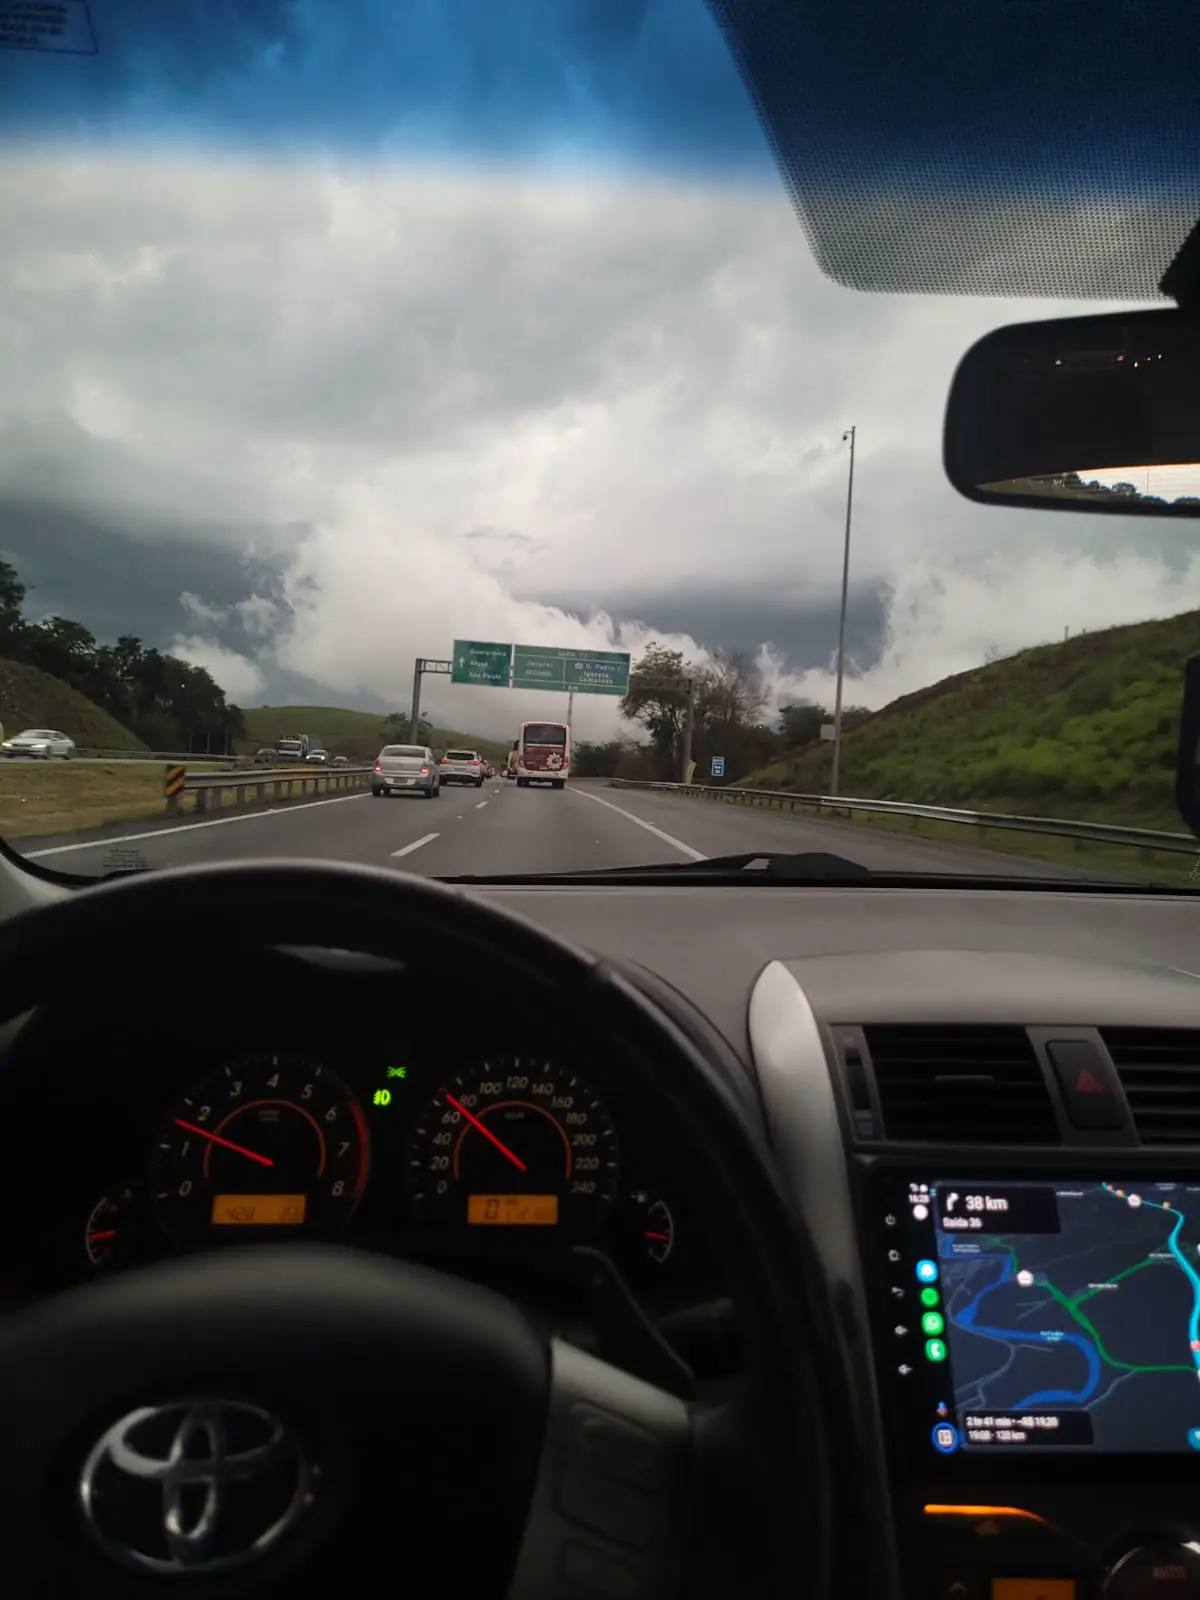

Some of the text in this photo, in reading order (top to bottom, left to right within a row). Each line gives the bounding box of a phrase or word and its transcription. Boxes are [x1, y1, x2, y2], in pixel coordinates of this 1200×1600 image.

[267, 1073, 280, 1088] 4
[507, 1076, 528, 1089] 120
[230, 1082, 243, 1097] 3
[302, 1084, 313, 1099] 5
[480, 1082, 501, 1094] 100
[532, 1083, 554, 1095] 140
[459, 1094, 477, 1106] 80
[552, 1096, 574, 1108] 160
[198, 1106, 211, 1121] 2
[325, 1107, 337, 1121] 6
[441, 1111, 461, 1124] 60
[566, 1112, 587, 1124] 180
[433, 1132, 451, 1145] 40
[572, 1133, 596, 1146] 200
[182, 1141, 190, 1157] 1
[338, 1142, 350, 1157] 7
[430, 1156, 449, 1169] 20
[575, 1157, 599, 1169] 220
[178, 1180, 192, 1196] 0
[332, 1180, 344, 1196] 8
[437, 1180, 448, 1194] 0
[571, 1181, 596, 1193] 240
[965, 1195, 1009, 1211] 38 km
